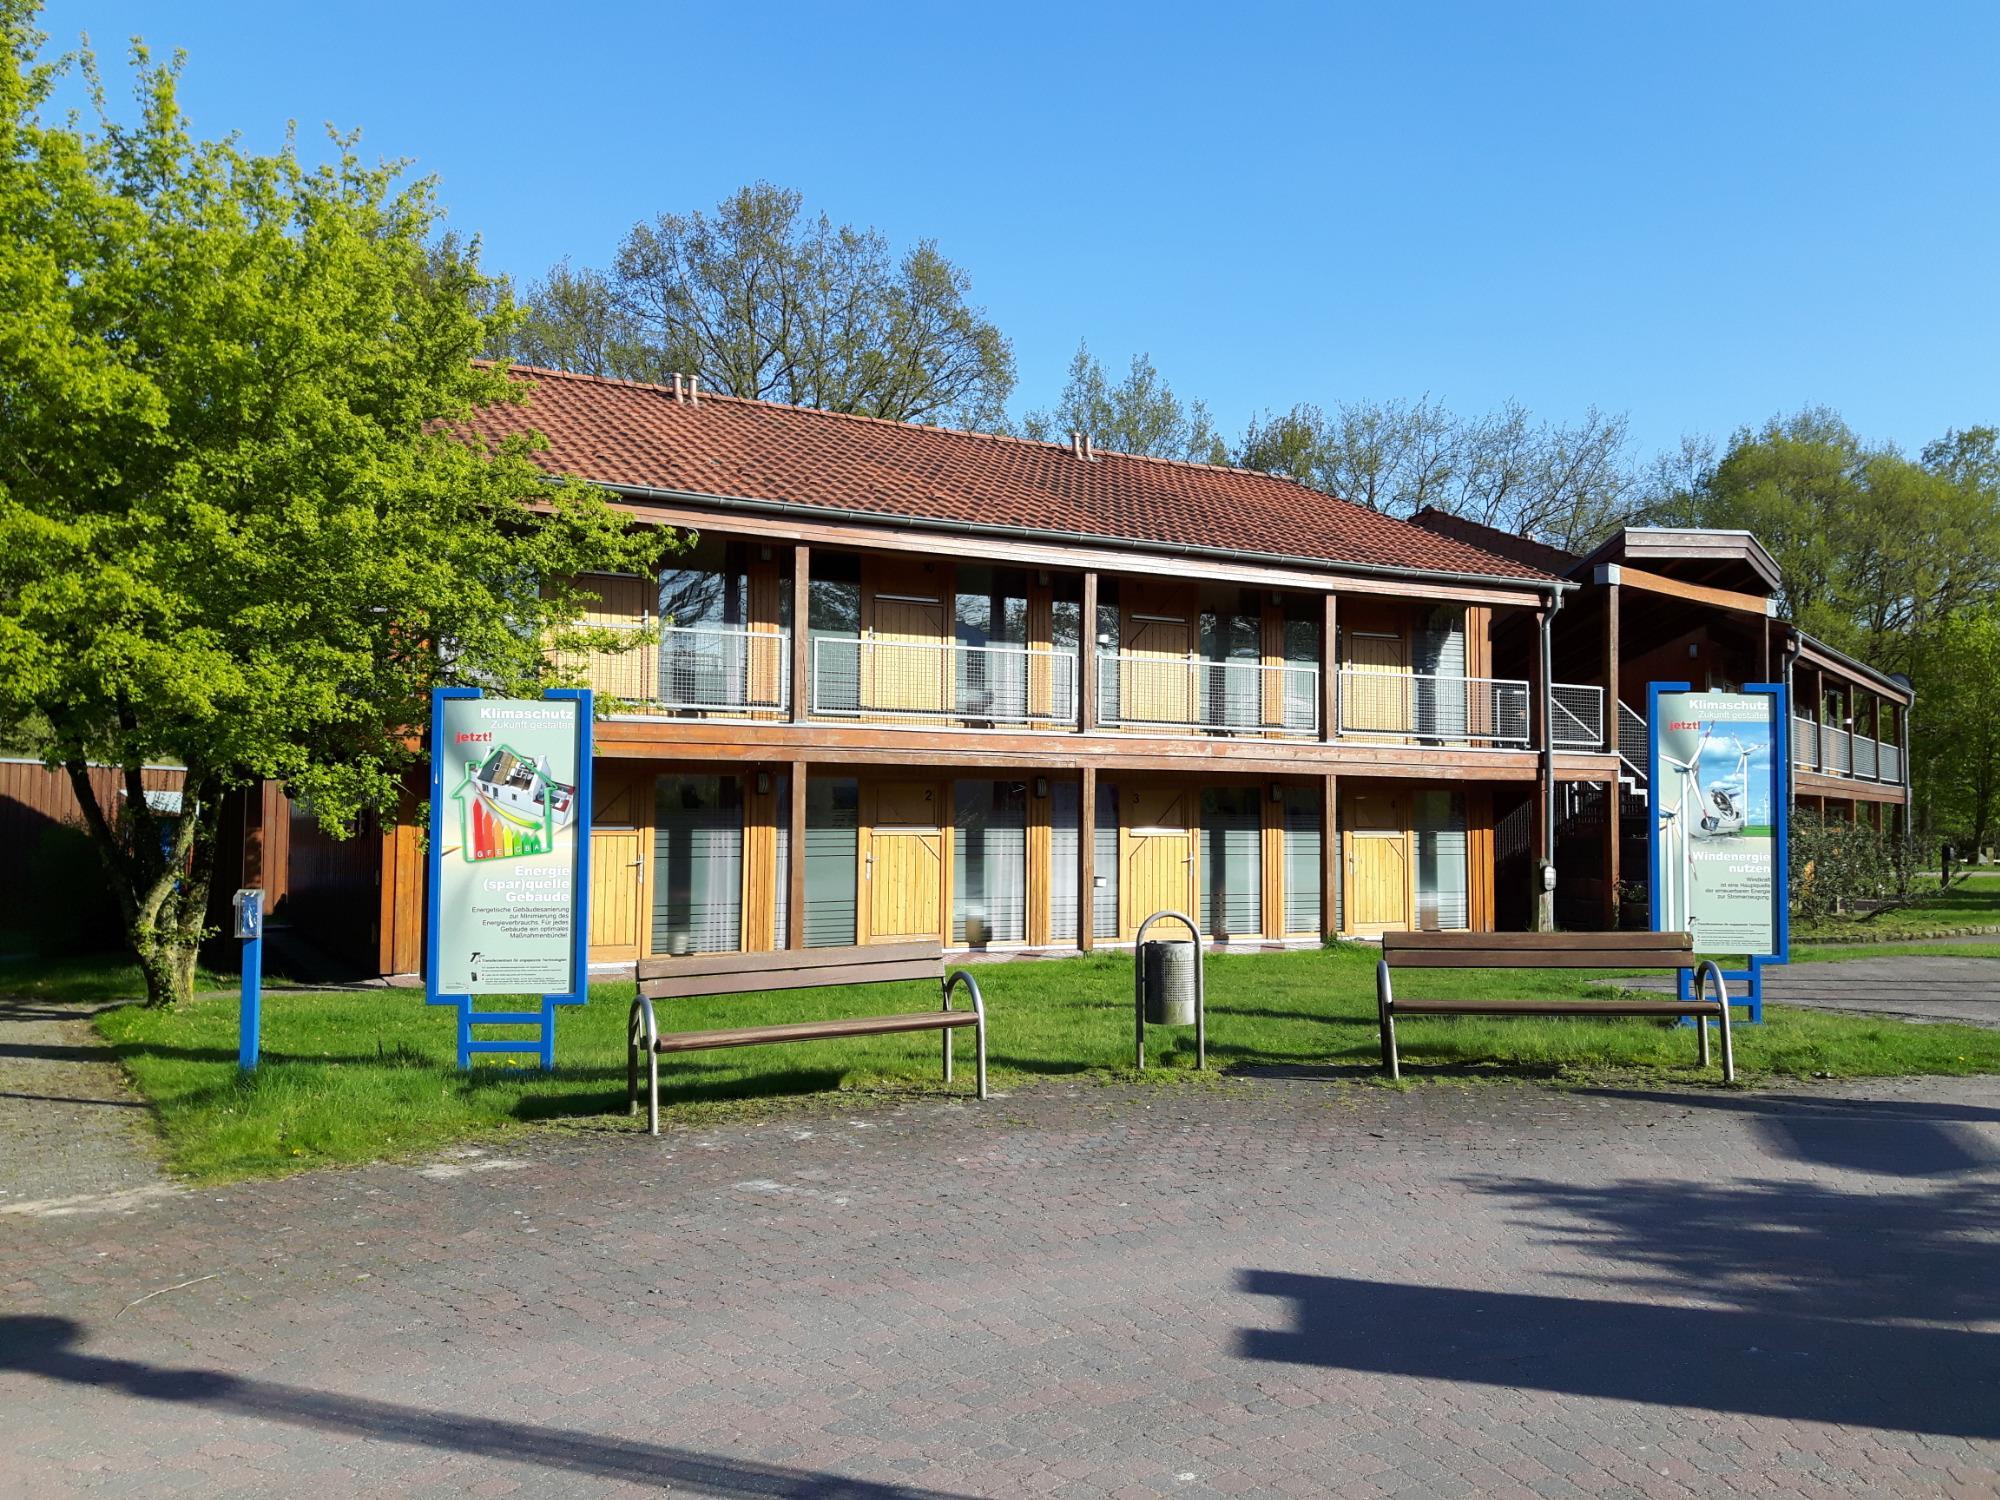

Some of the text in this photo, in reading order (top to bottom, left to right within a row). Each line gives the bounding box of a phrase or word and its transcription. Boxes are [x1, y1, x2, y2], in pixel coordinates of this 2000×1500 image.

[1689, 700, 1768, 710] Klimaschutz
[480, 707, 574, 719] Klimaschutz
[1698, 711, 1729, 719] Zukunft
[490, 720, 574, 730] Zukunft gestalten
[1669, 721, 1701, 732] jetzt!
[456, 731, 493, 743] jetzt!
[924, 790, 932, 801] 2
[1132, 792, 1140, 804] 3
[1691, 851, 1770, 863] Windenergie
[515, 866, 570, 878] Energie
[1728, 864, 1770, 873] nutzen
[483, 878, 570, 892] (spar)quelle
[471, 906, 570, 914] Energetische Gebäudesanierung
